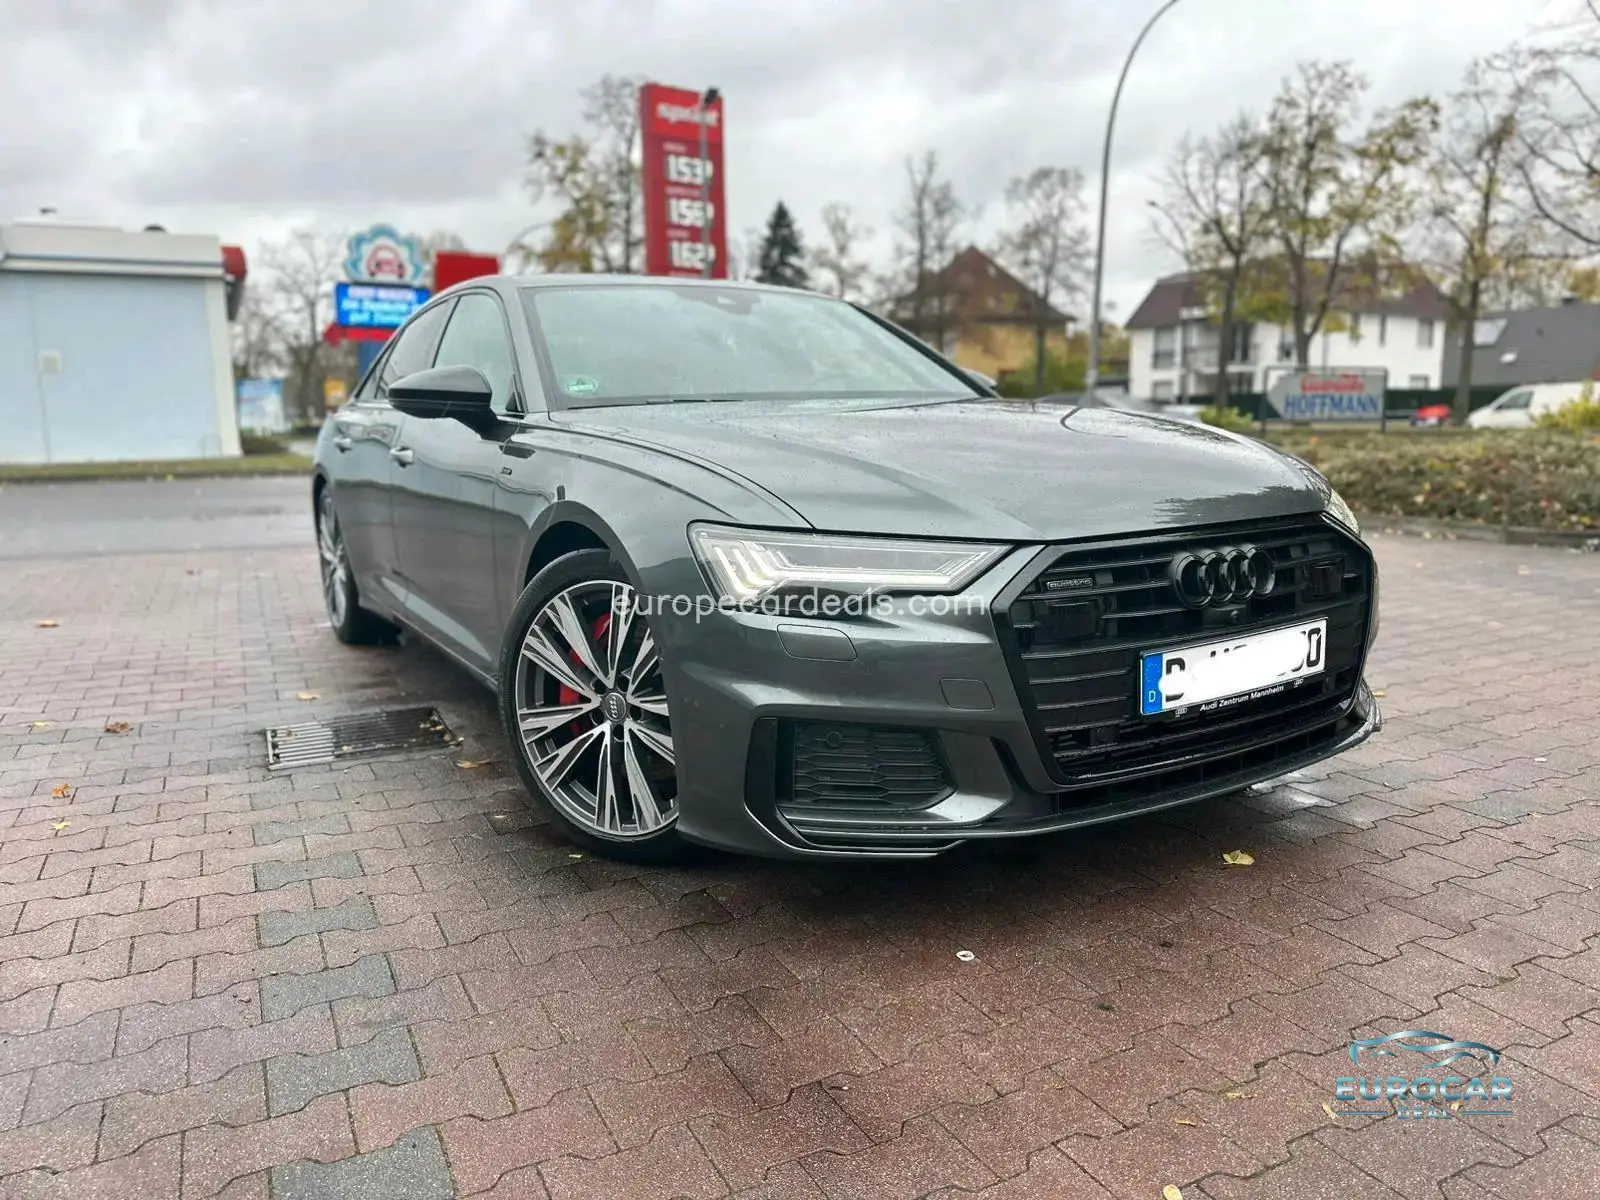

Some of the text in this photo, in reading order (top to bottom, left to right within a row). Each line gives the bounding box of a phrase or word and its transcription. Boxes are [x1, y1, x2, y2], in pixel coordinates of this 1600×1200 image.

[1048, 578, 1092, 590] quattro
[1148, 690, 1156, 703] D
[1199, 685, 1285, 712] Audi Zentrum Mannheim
